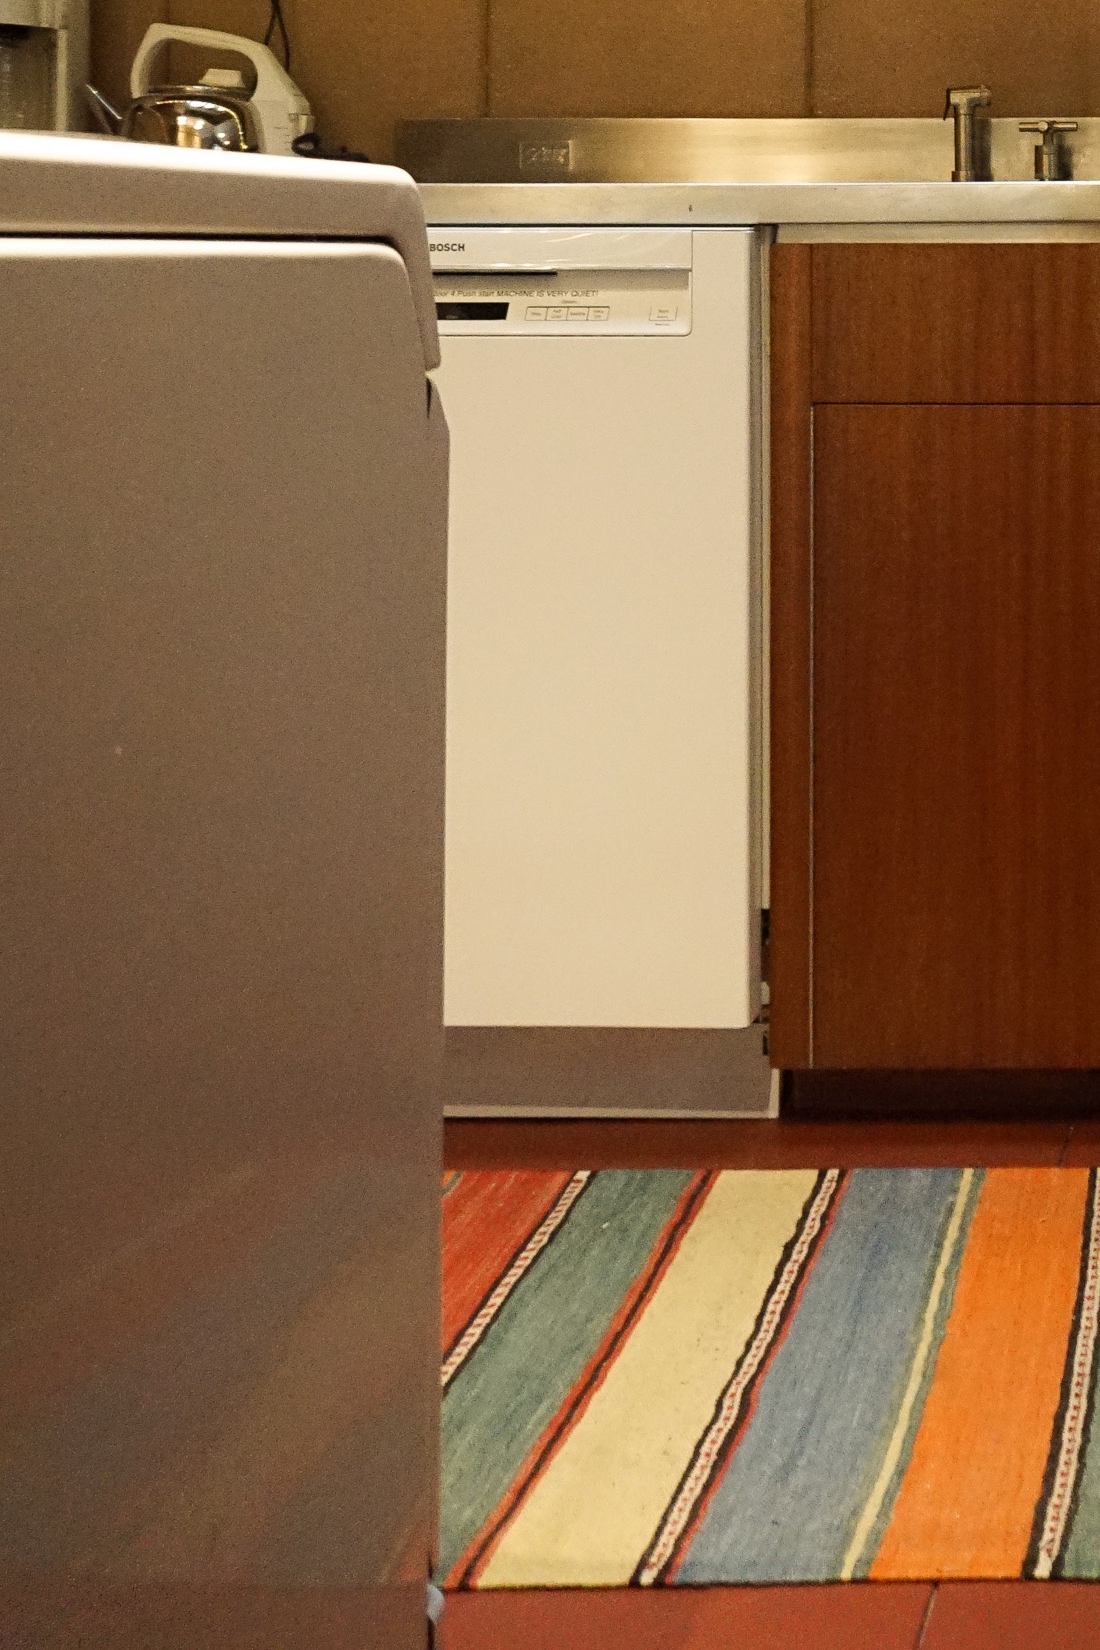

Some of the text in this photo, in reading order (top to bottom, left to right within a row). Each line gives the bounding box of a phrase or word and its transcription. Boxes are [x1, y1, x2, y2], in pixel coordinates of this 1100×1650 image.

[429, 243, 465, 252] BOSCH
[496, 290, 535, 298] MACHINE
[570, 290, 599, 298] QUIET!
